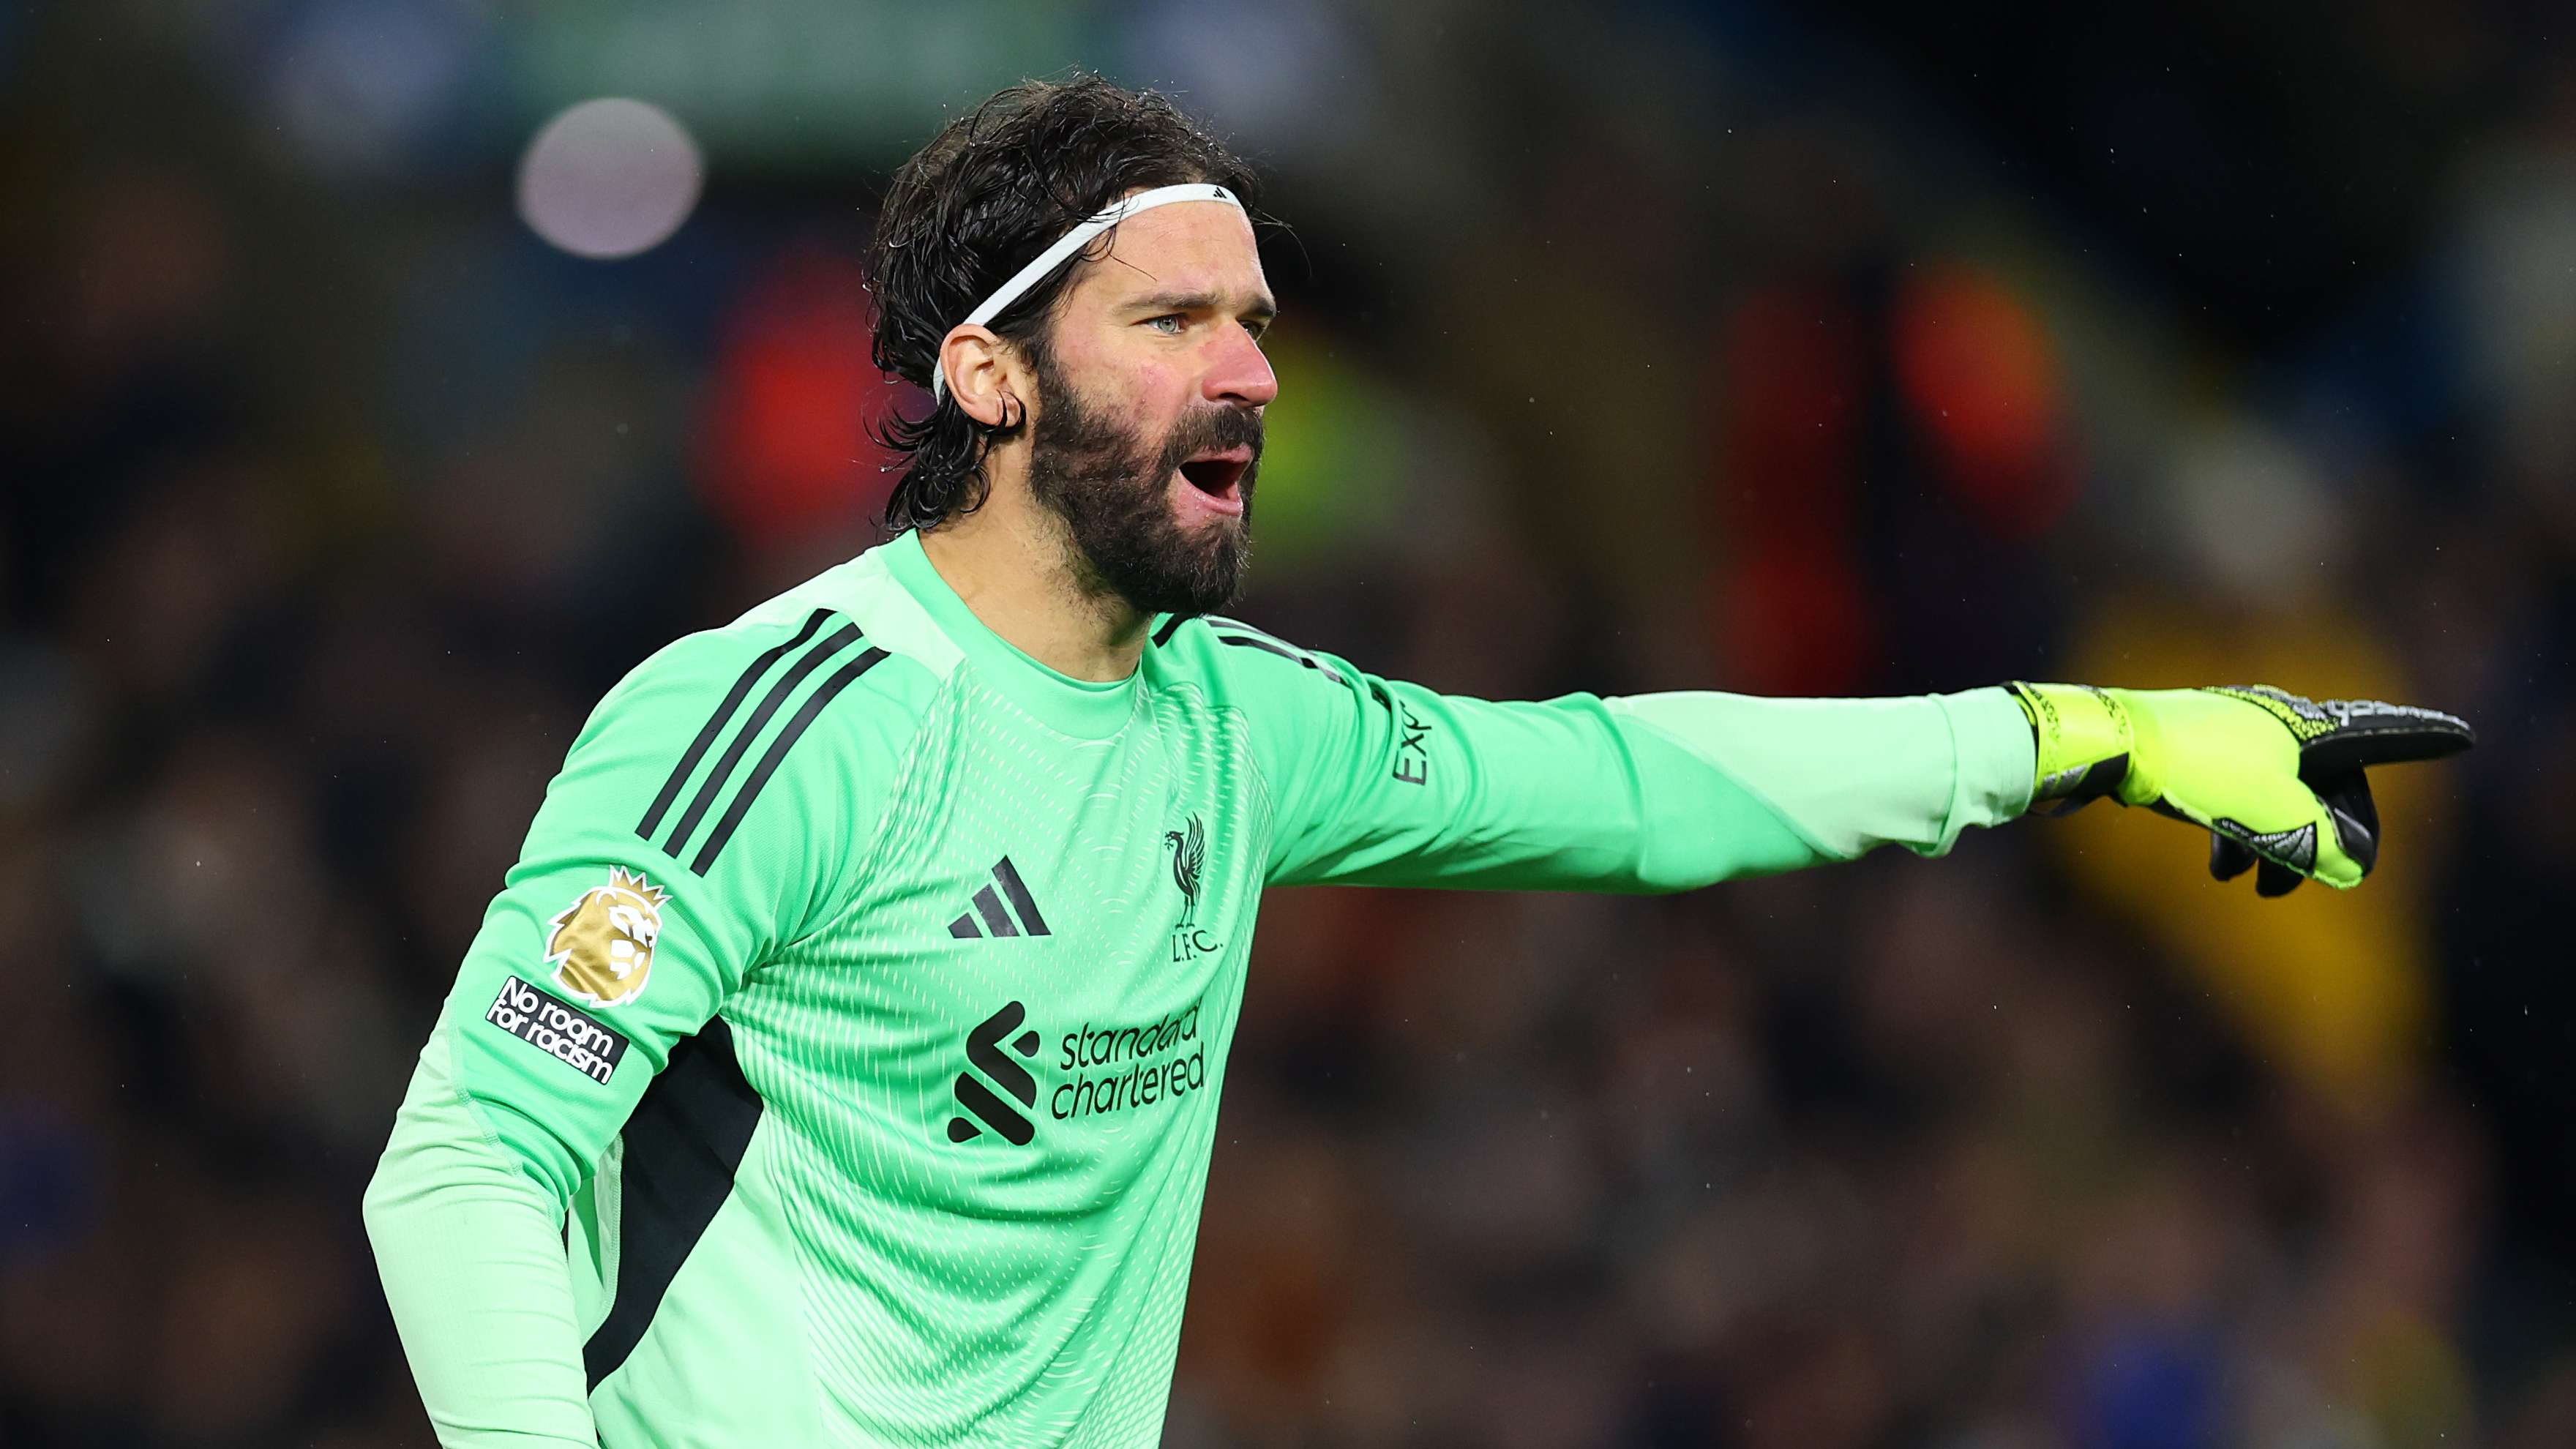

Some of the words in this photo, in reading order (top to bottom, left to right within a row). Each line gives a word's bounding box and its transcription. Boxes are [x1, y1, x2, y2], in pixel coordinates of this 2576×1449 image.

[1172, 929, 1224, 962] L.F.C.
[486, 998, 529, 1033] for
[525, 1022, 613, 1085] racism
[498, 976, 539, 1013] No
[538, 1002, 614, 1057] room
[1051, 1041, 1204, 1120] chartered
